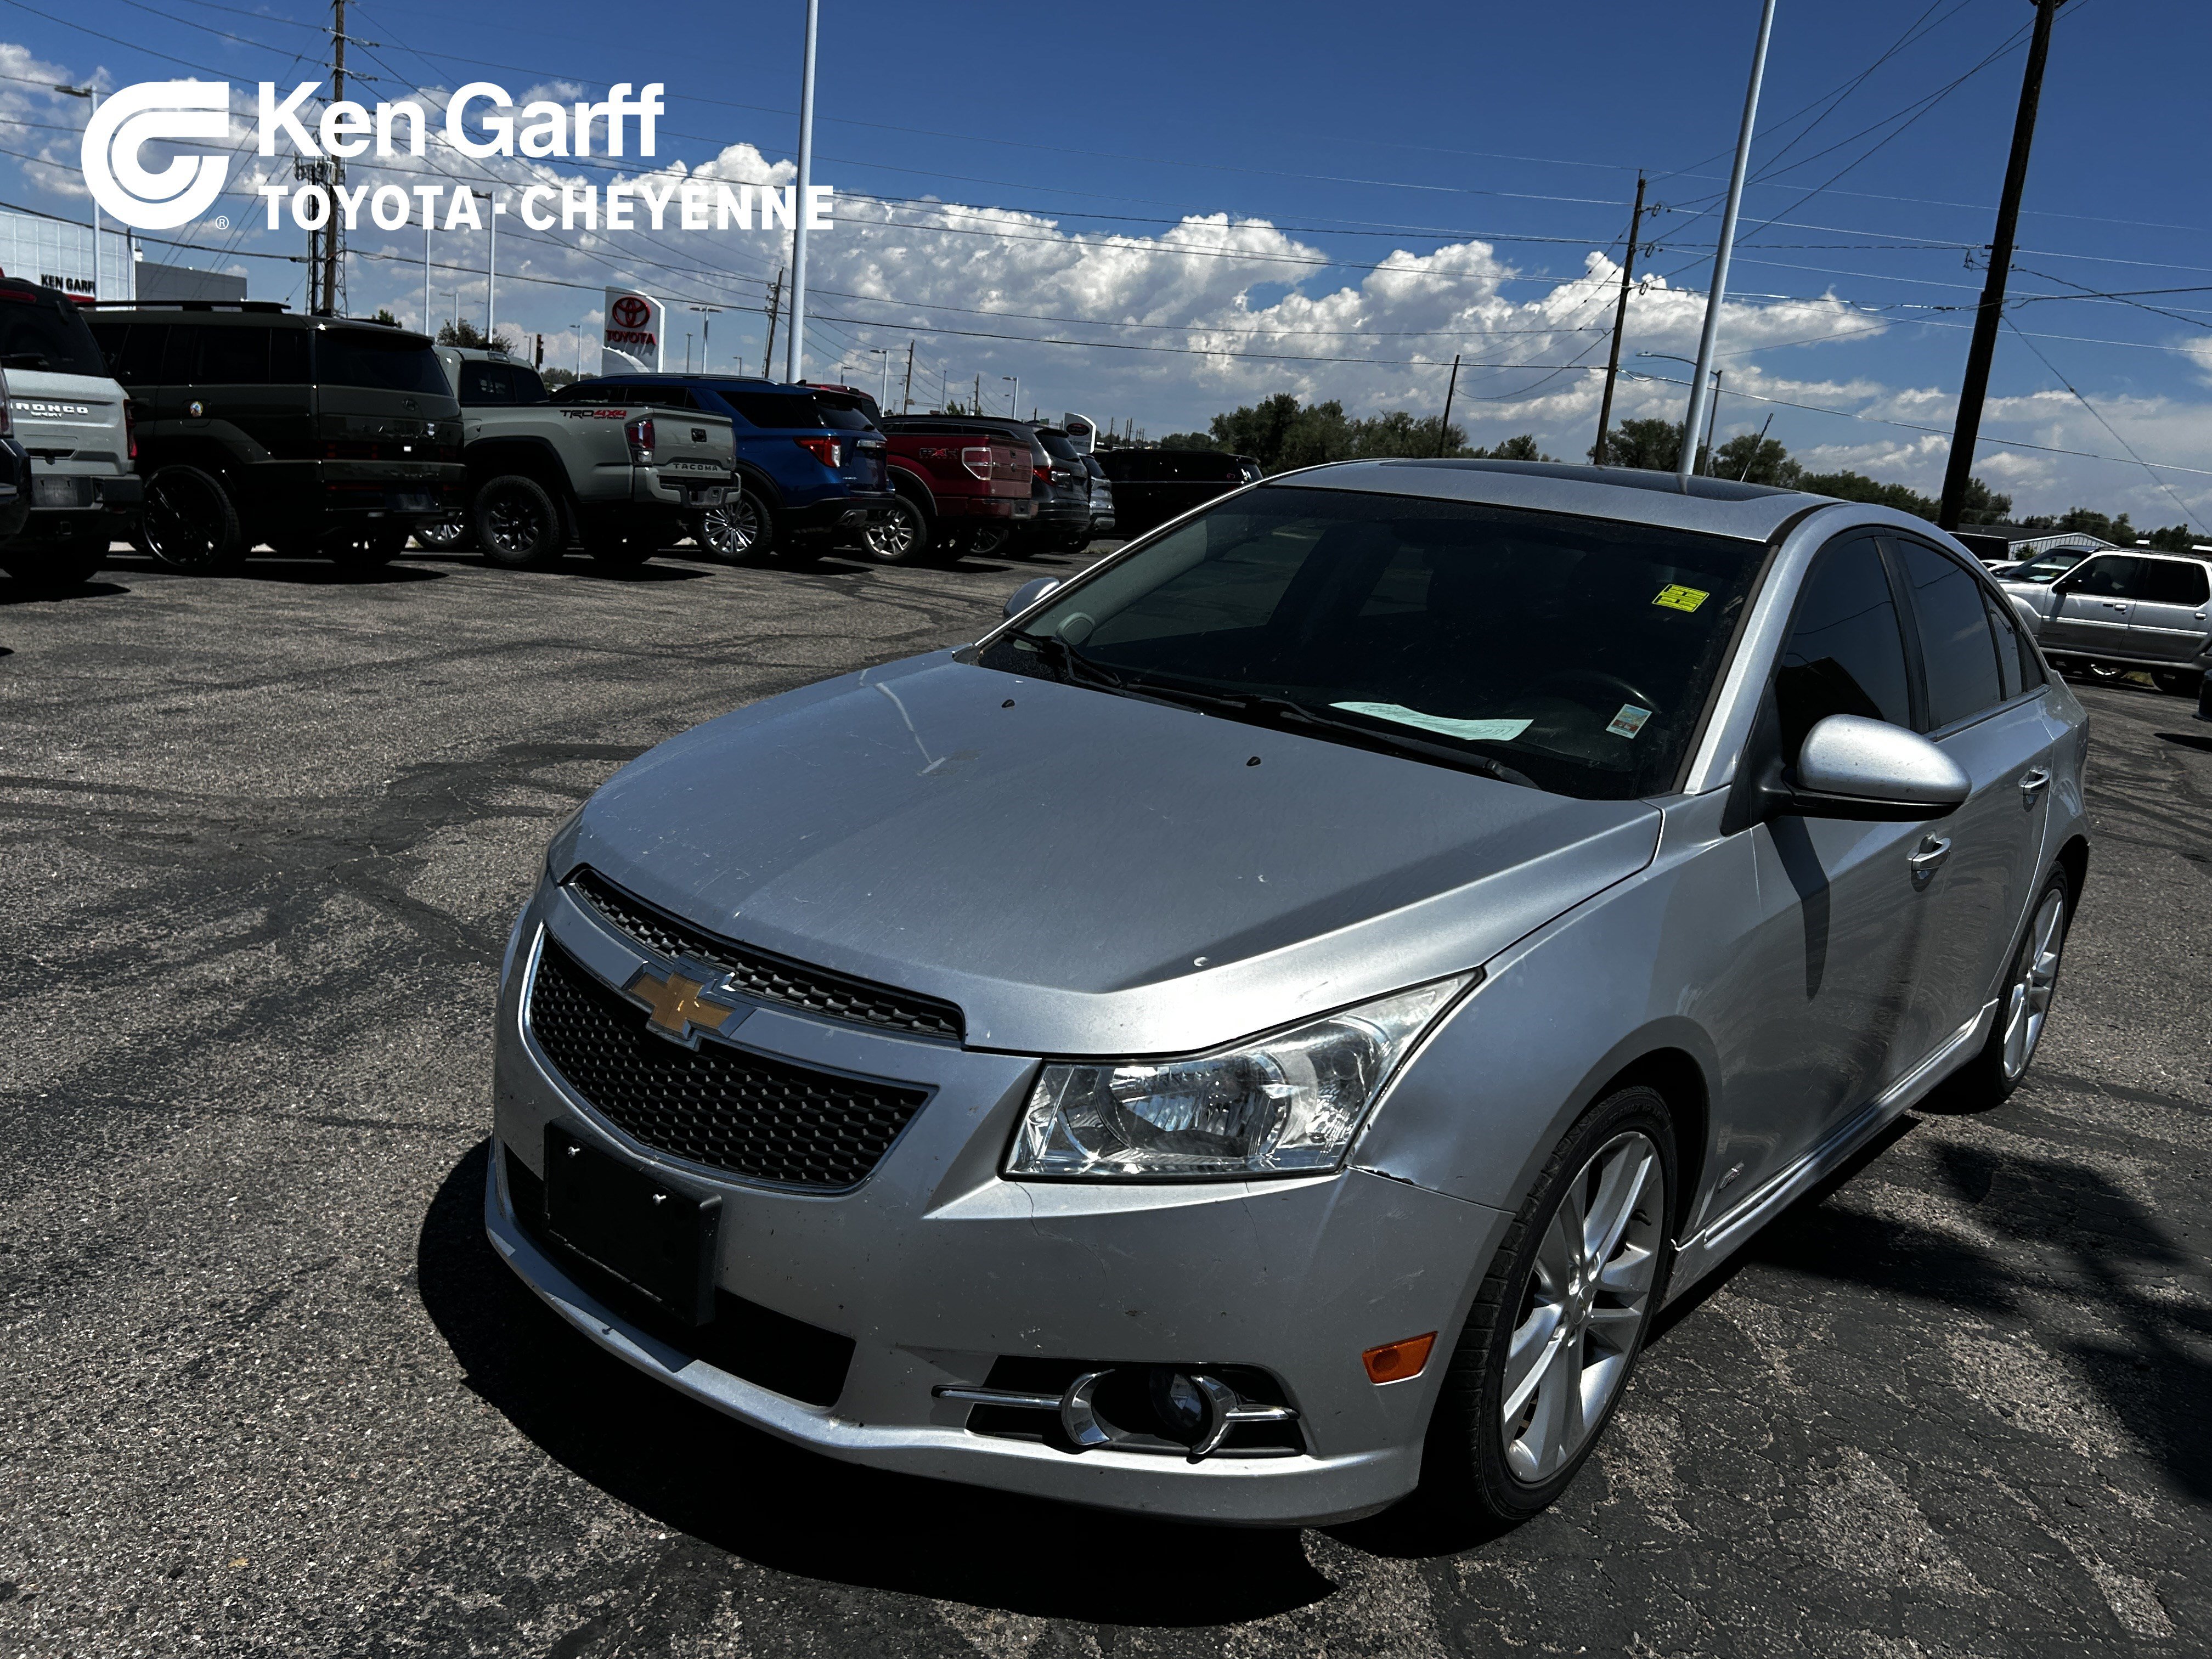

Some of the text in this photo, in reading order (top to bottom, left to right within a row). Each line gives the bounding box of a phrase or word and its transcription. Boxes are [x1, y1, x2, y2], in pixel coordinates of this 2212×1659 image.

[41, 274, 63, 290] KEN
[606, 330, 657, 346] TOYOTA
[10, 402, 88, 415] RONCO
[673, 463, 718, 471] TACOMA
